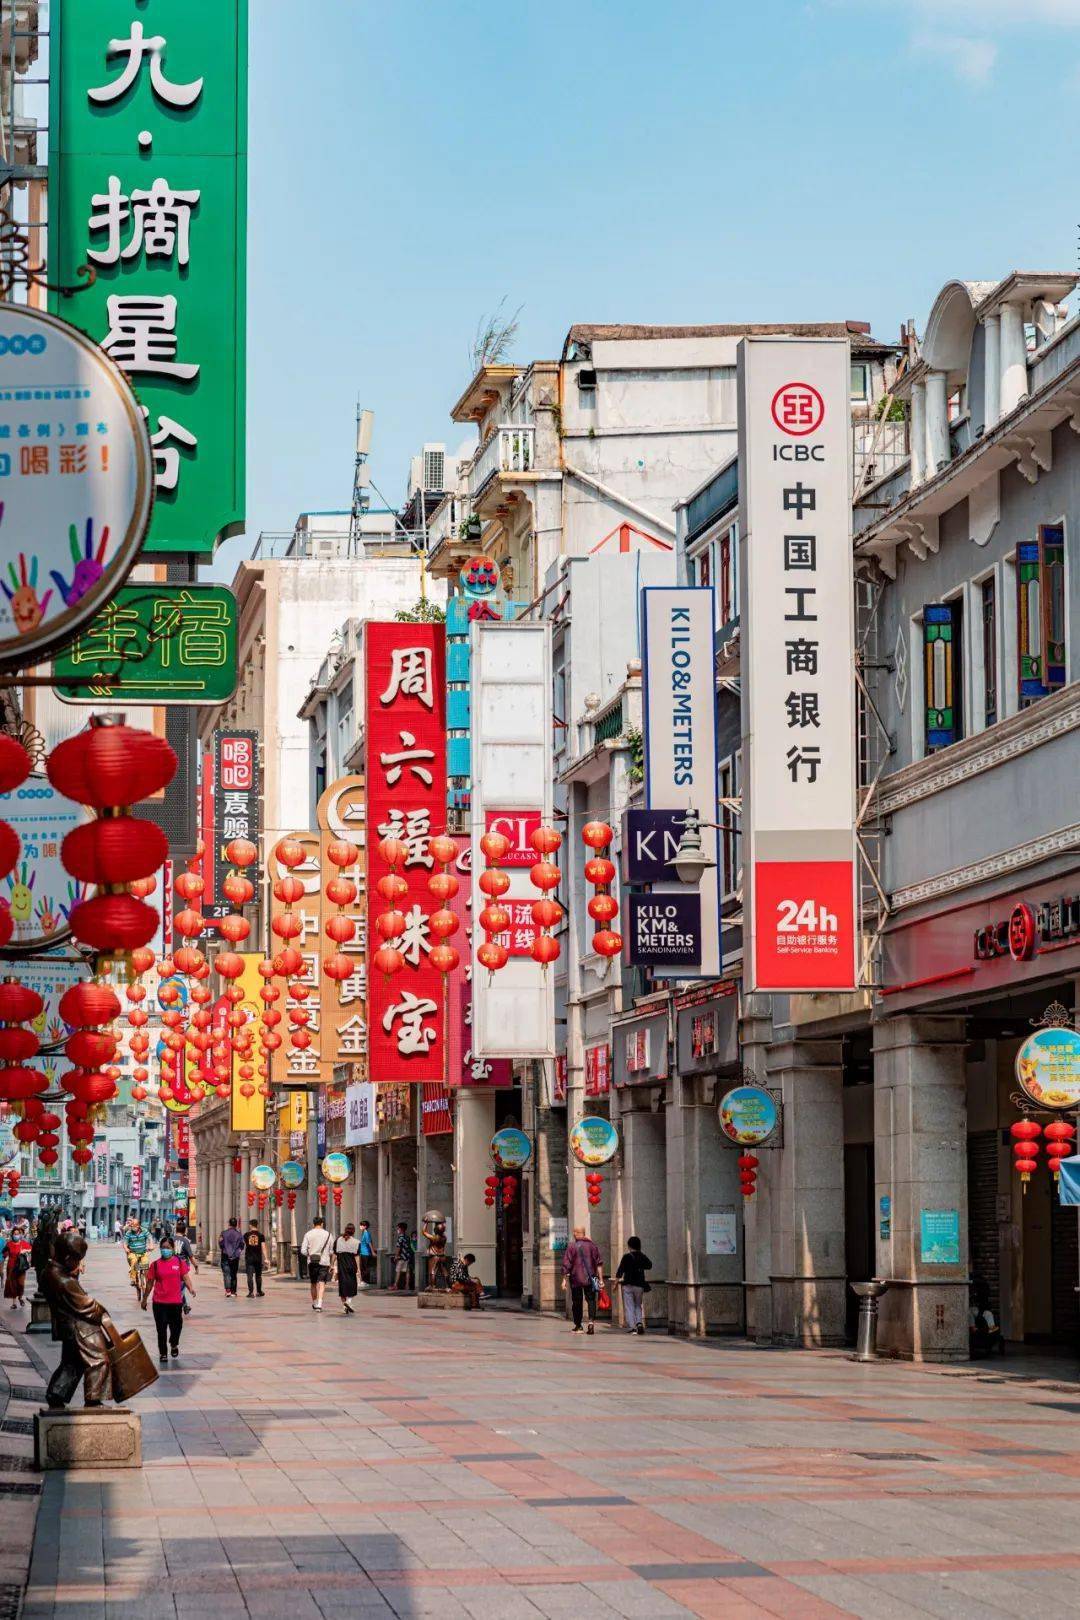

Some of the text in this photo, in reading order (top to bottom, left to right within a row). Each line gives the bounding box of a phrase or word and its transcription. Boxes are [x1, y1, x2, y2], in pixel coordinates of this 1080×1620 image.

[773, 444, 825, 461] ICBC
[71, 590, 231, 667] 住宿
[783, 482, 821, 783] 中国工商银行
[671, 608, 693, 786] KILO&METERS
[223, 742, 250, 787] 唱吧
[378, 646, 437, 1054] 周六福珠宝
[213, 907, 230, 918] 2F
[637, 905, 677, 918] KILO
[776, 899, 838, 932] 24h
[199, 927, 215, 939] 2F
[637, 918, 679, 934] KM&
[637, 934, 694, 947] METERS
[776, 935, 838, 946] 自助银行服务
[637, 946, 694, 954] SKANDINAVIEN
[776, 946, 838, 955] Self-Service Banking
